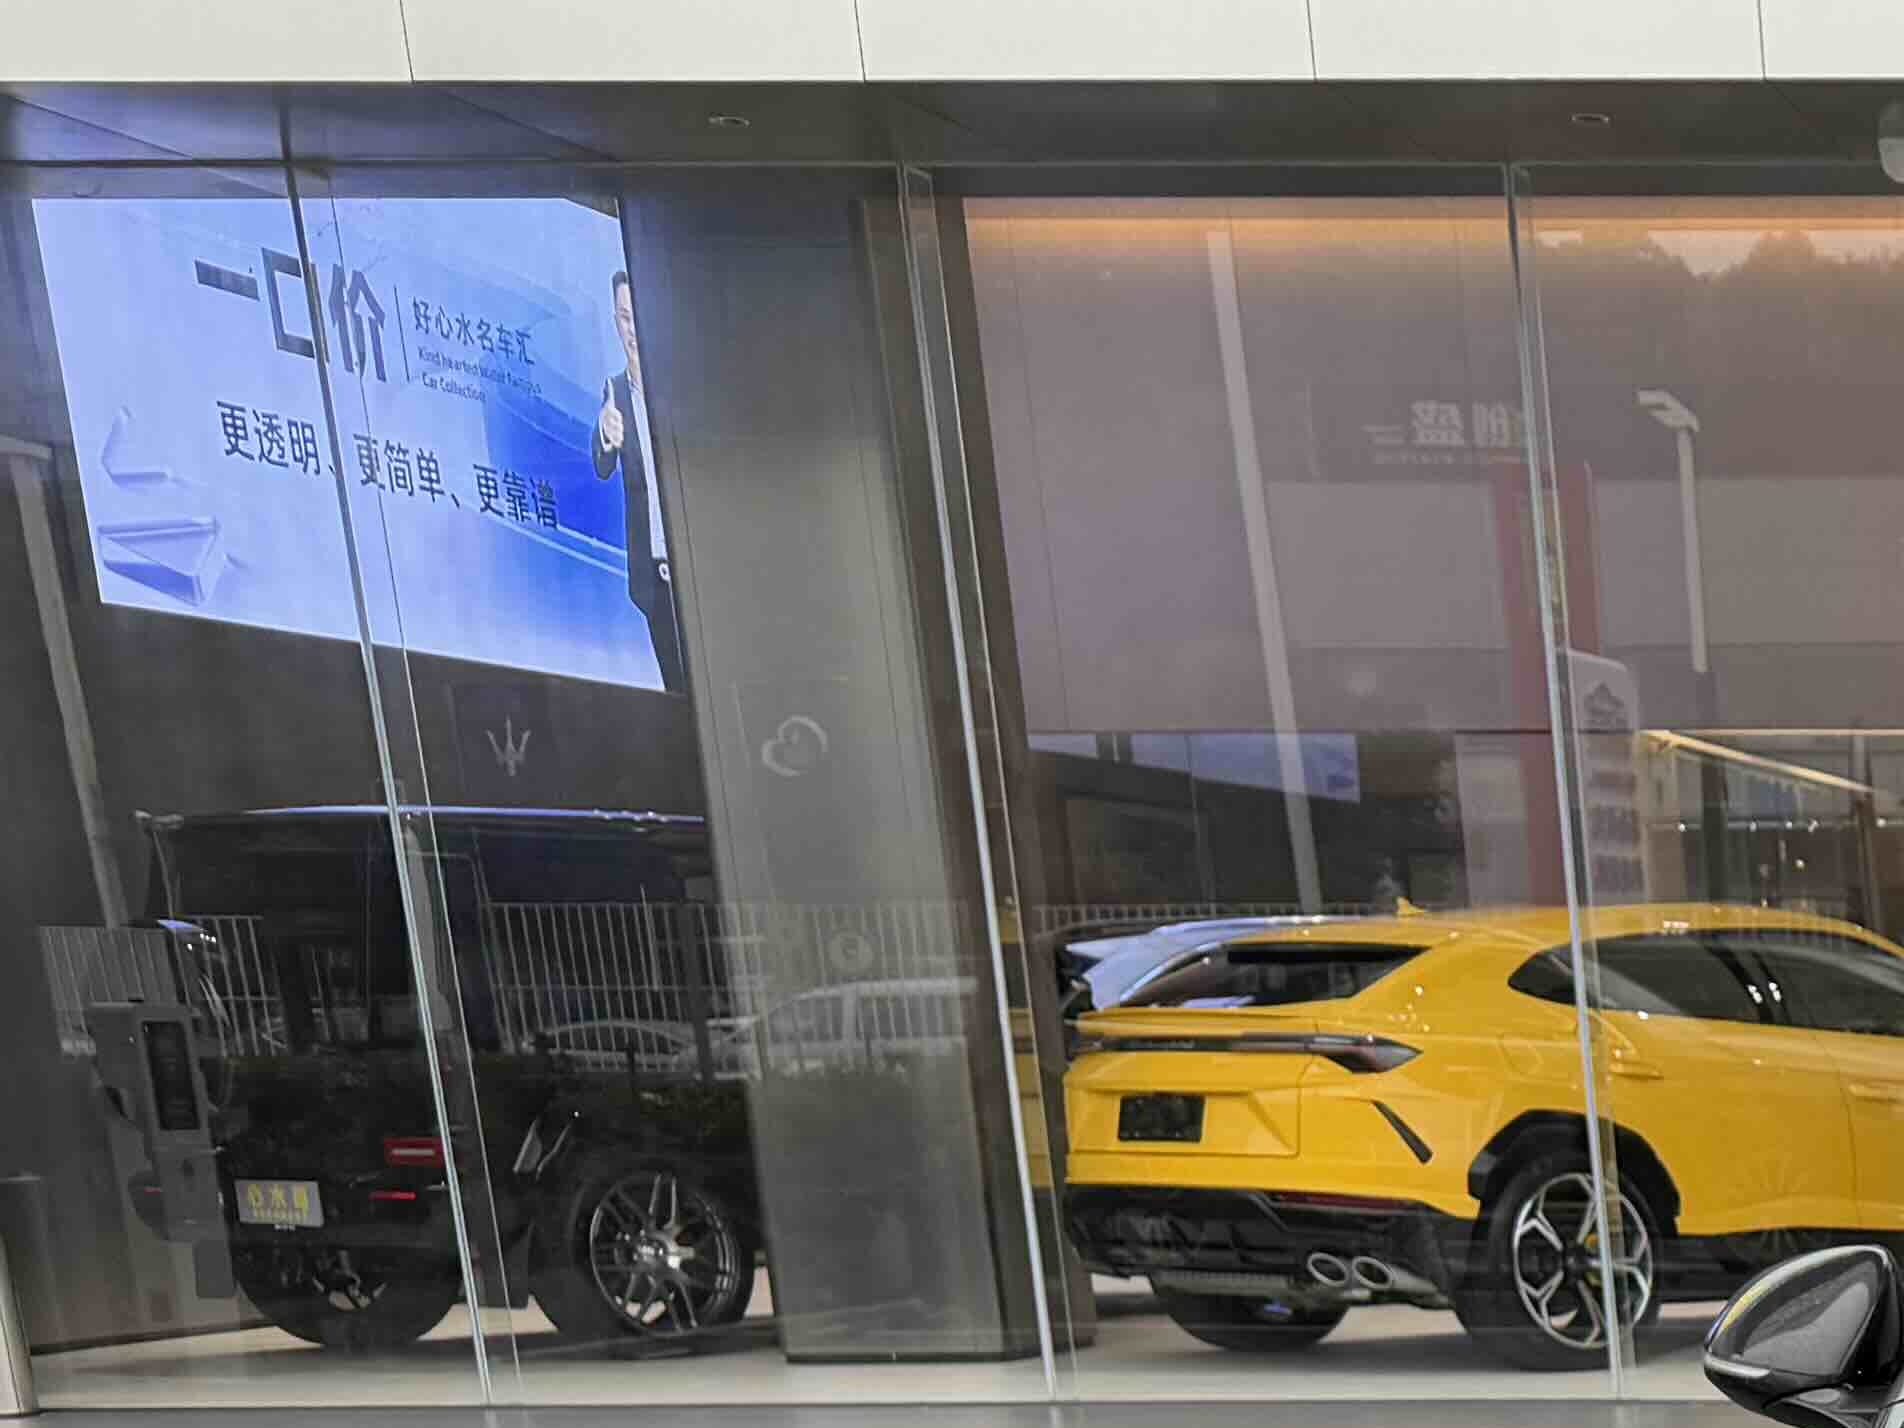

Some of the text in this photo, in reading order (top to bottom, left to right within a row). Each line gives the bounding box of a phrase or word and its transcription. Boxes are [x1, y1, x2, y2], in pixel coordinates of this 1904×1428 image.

[194, 246, 387, 383] 一口价
[412, 296, 535, 366] 好心水名车汇
